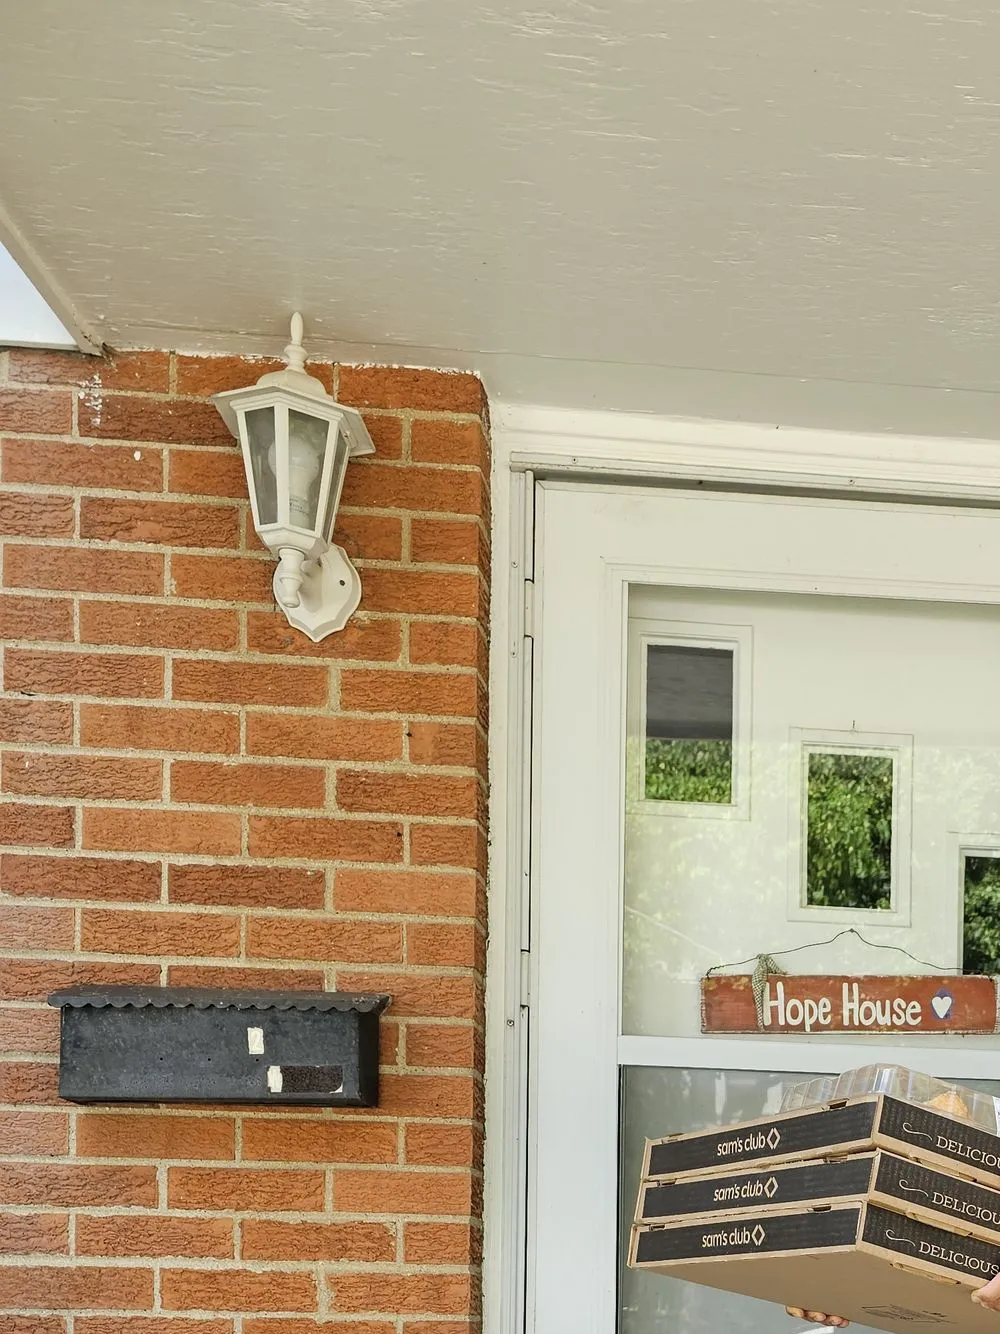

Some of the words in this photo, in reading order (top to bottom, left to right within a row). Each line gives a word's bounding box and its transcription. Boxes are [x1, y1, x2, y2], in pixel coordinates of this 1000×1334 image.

[763, 981, 832, 1032] Hope
[842, 982, 922, 1026] House
[717, 1137, 743, 1156] sam's
[744, 1132, 766, 1151] club
[713, 1184, 741, 1202] sam's
[741, 1180, 763, 1198] club
[702, 1230, 728, 1248] sam's
[729, 1226, 751, 1245] club
[918, 1241, 1000, 1276] DELICIOUS
